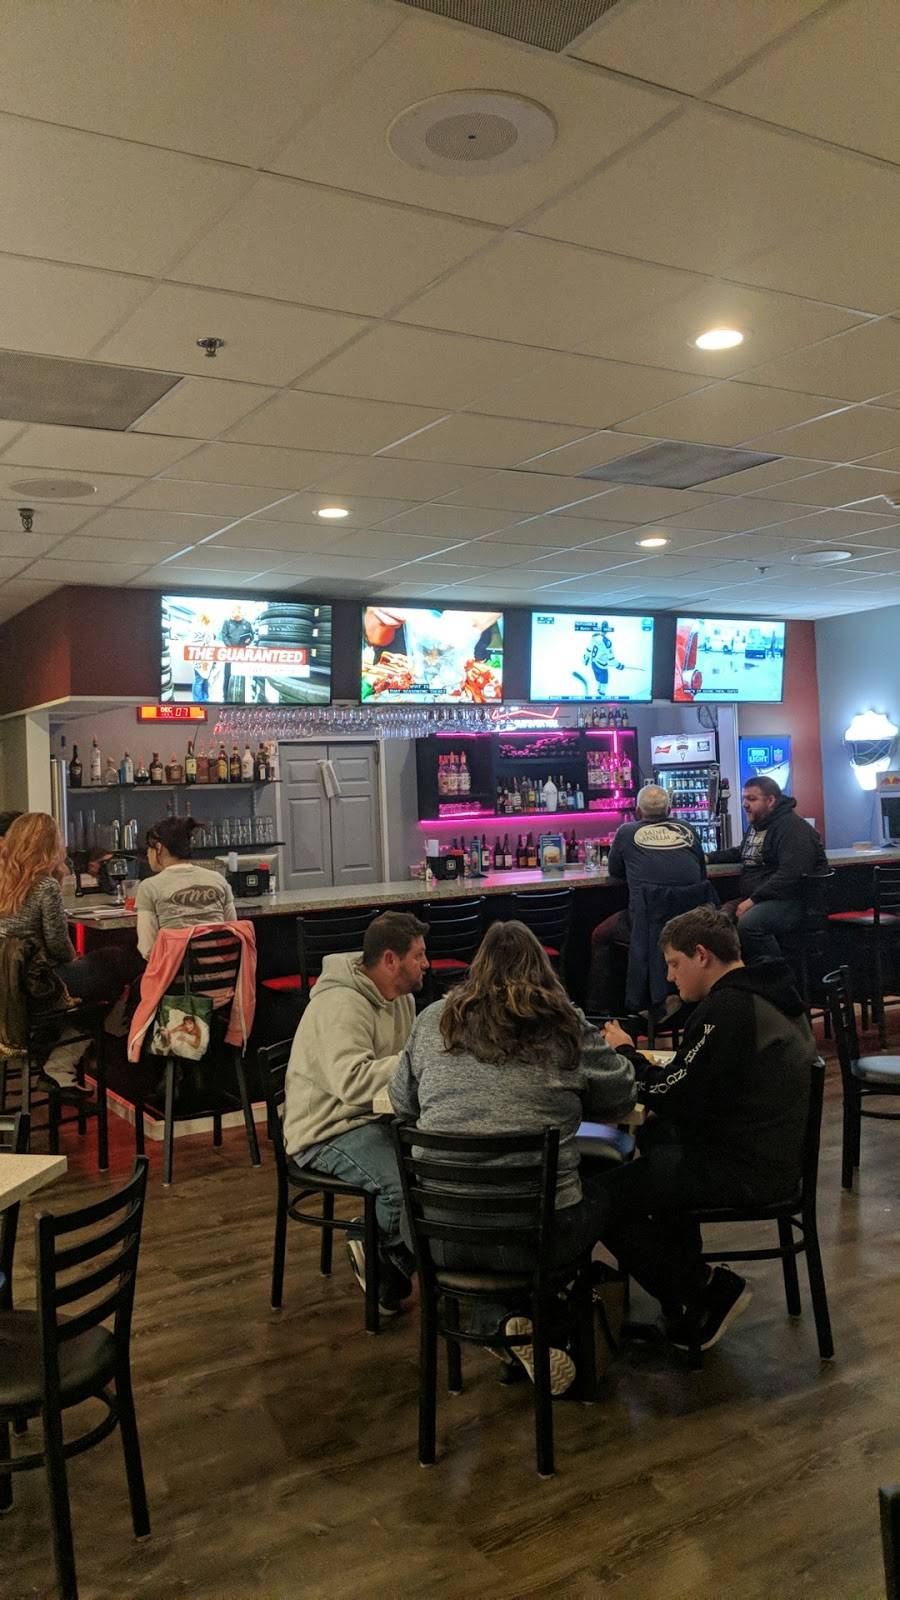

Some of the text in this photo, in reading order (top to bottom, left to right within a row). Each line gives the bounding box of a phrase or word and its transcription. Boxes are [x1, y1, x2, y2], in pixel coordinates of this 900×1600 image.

[187, 647, 304, 664] THE GUARANTEED
[175, 707, 189, 717] 07
